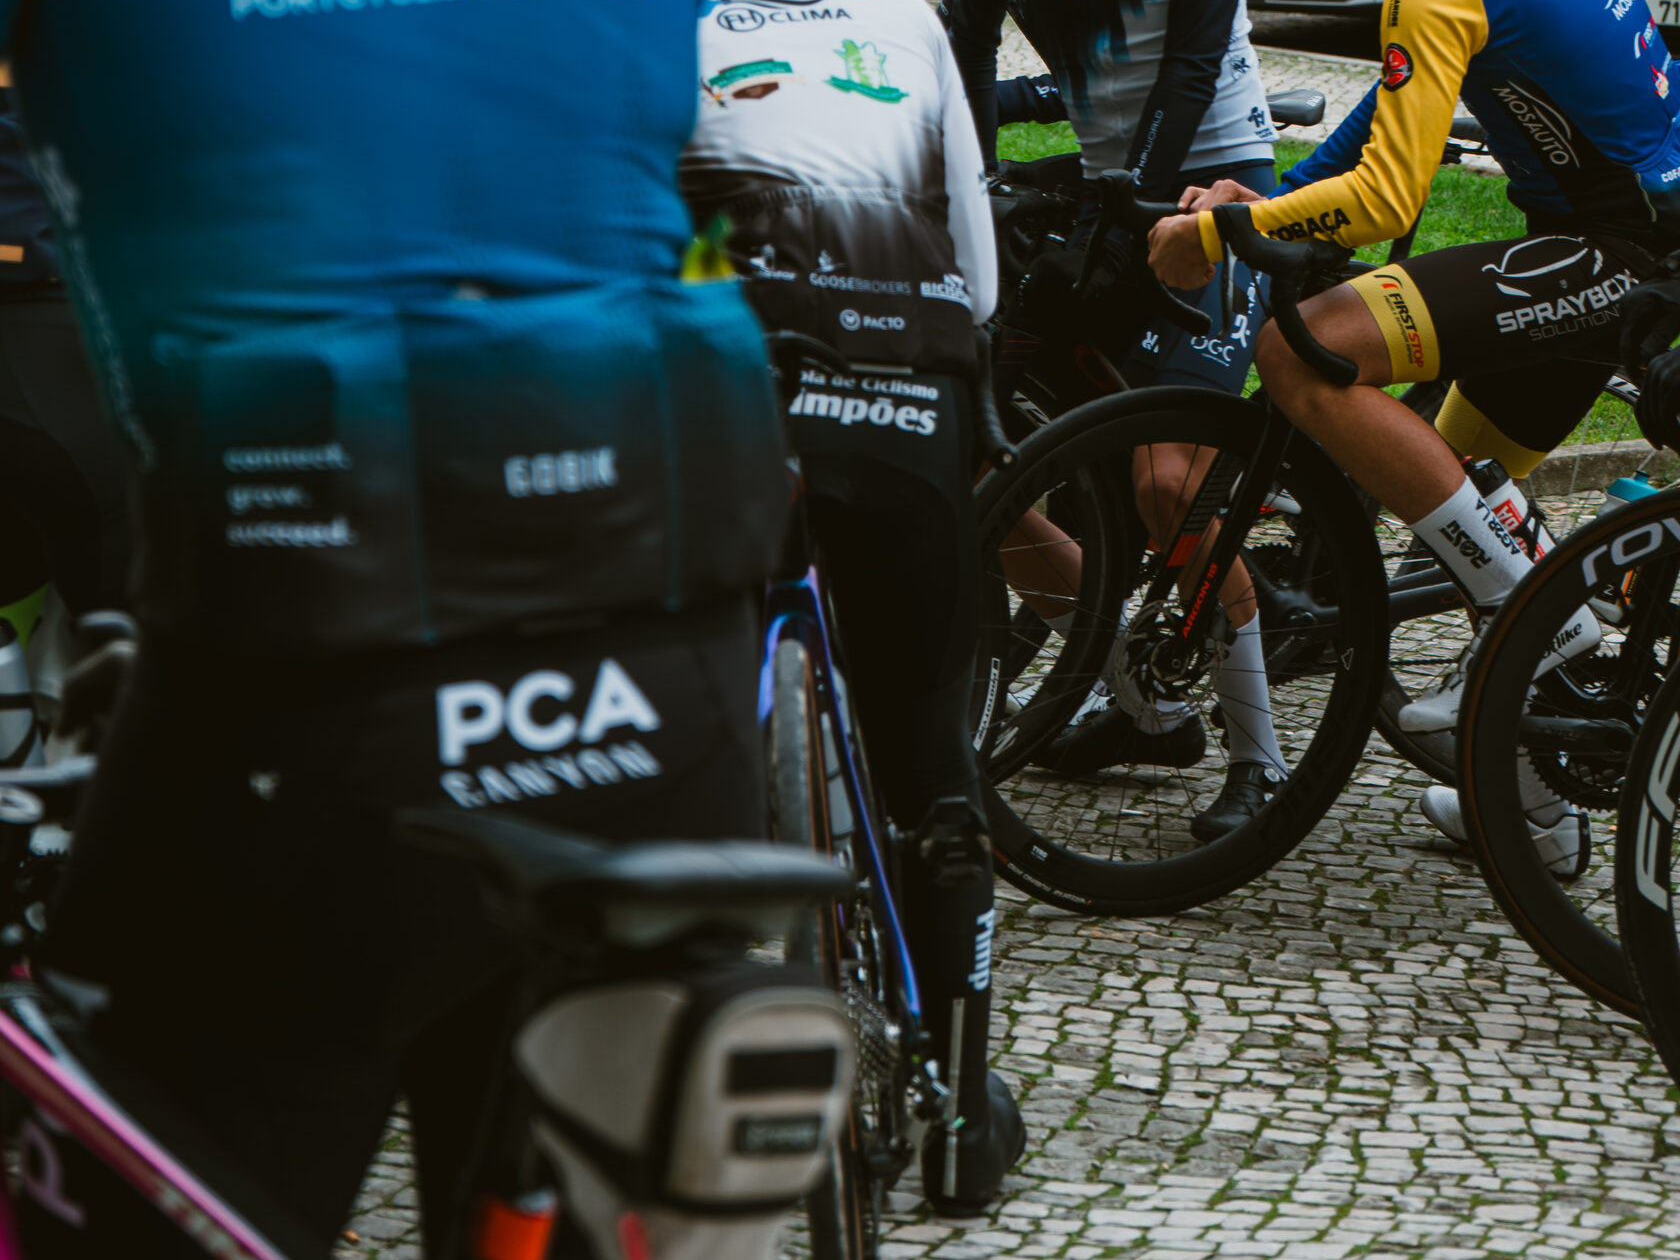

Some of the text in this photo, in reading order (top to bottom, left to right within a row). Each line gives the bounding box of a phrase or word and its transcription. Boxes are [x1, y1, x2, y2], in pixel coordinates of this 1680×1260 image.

[769, 8, 852, 23] CLIMA
[1492, 87, 1569, 166] MOSAUTO
[863, 315, 905, 331] PACTO
[1496, 268, 1639, 334] SPRAYBOX
[861, 377, 938, 401] Ciclismo
[435, 657, 661, 767] PCA
